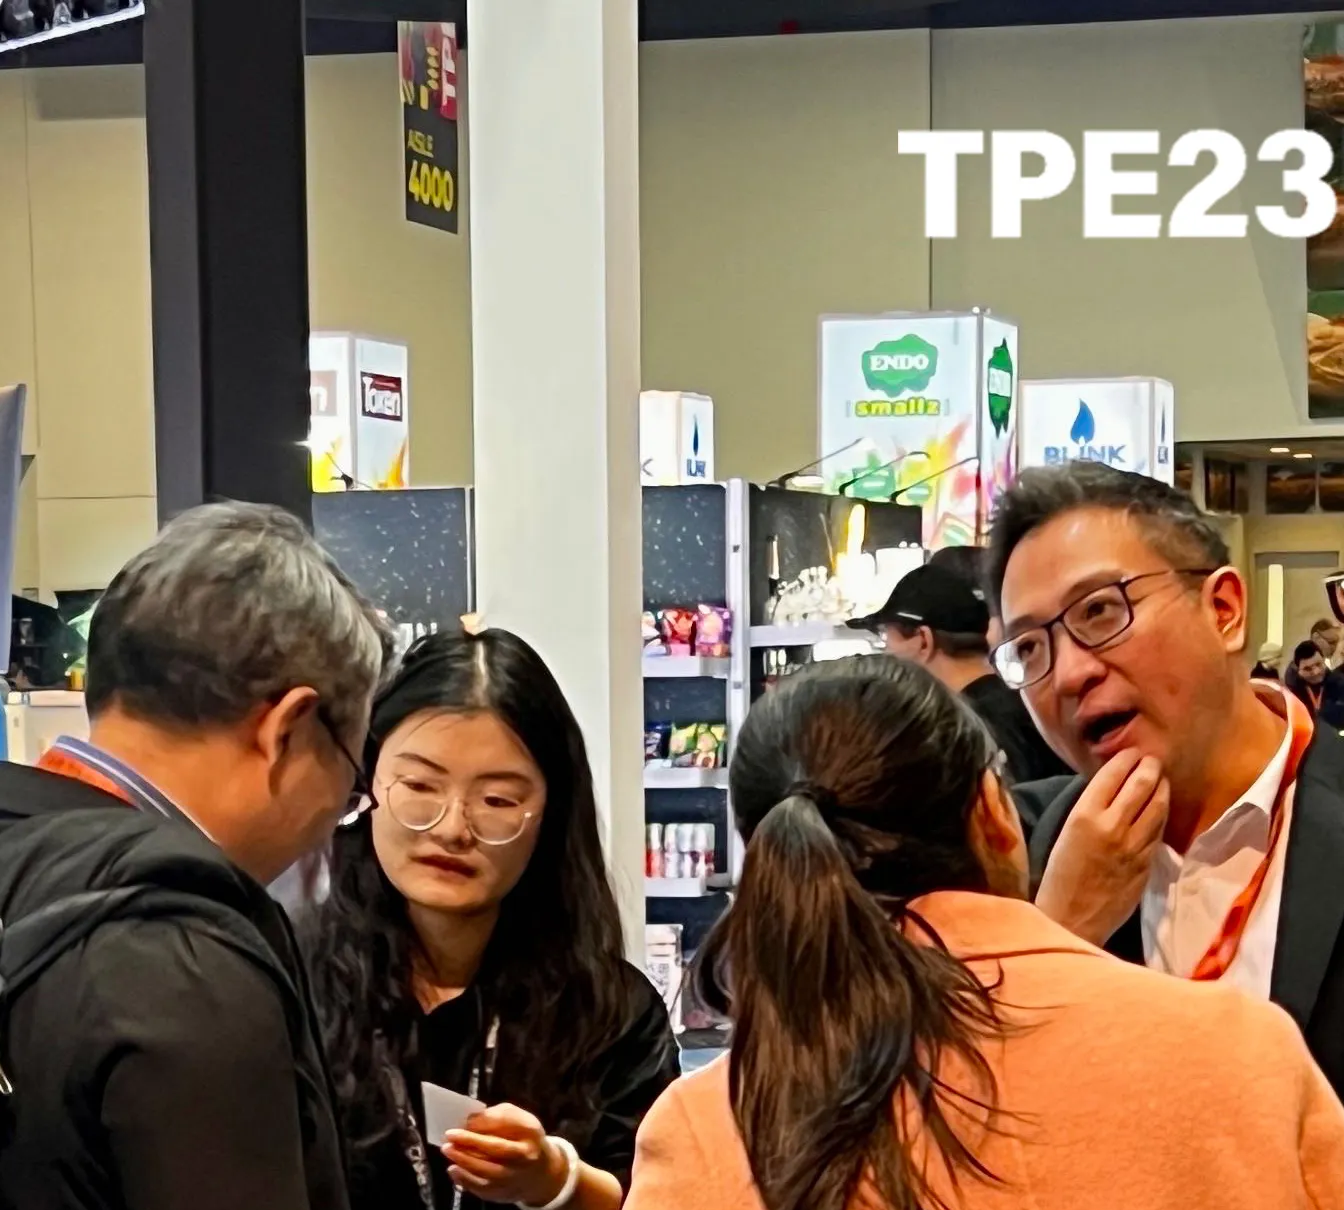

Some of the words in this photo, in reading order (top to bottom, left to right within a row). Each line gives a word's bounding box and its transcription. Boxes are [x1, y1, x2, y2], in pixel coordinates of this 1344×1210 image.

[409, 160, 454, 212] 4000
[869, 354, 930, 371] ENDO
[855, 397, 941, 417] smallz
